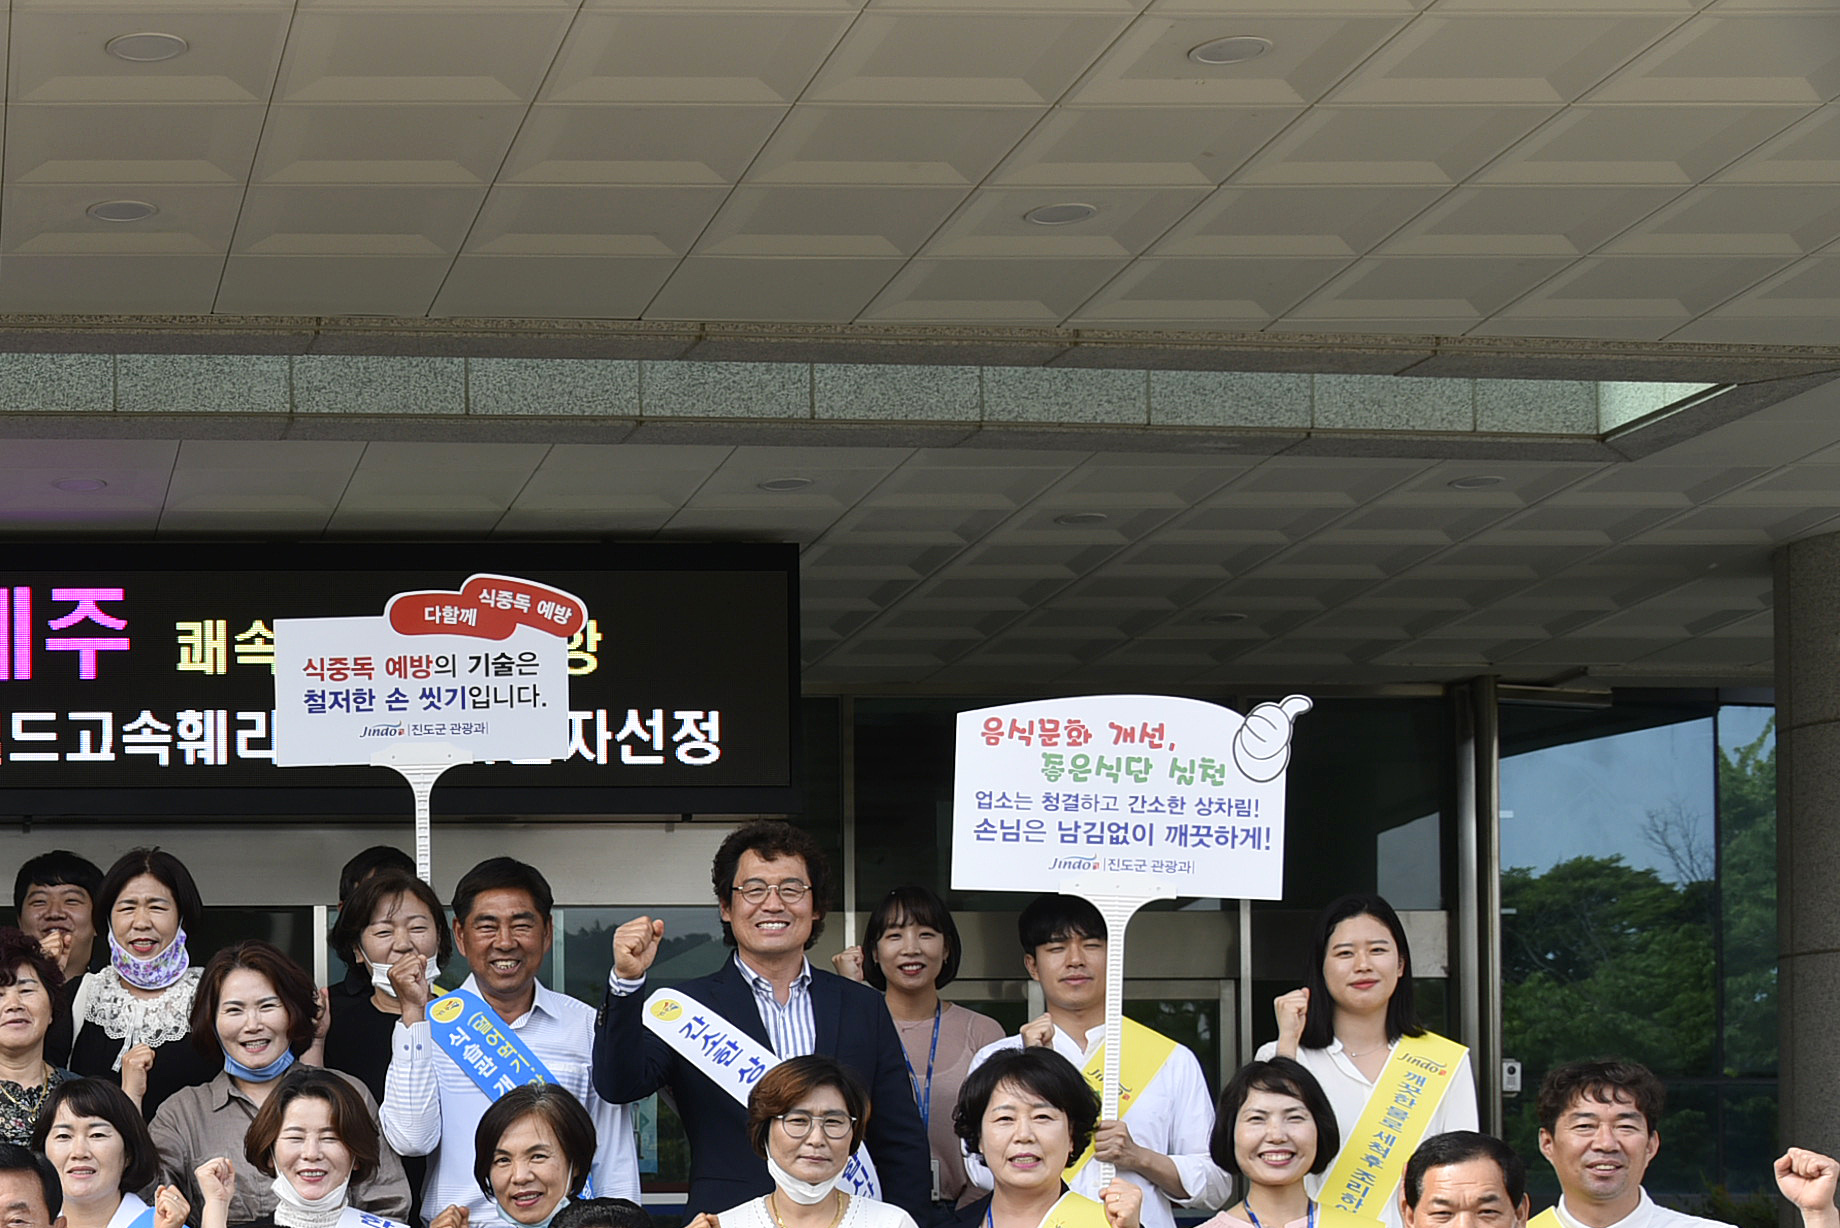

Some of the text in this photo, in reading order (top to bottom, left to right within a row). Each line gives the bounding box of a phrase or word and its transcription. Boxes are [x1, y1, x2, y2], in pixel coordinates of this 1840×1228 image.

[424, 605, 477, 626] 다함께
[479, 589, 572, 624] 식중독 예방
[303, 652, 539, 682] 식중독 예방의 기술은
[303, 684, 547, 714] 철저한 손 씻기입니다.
[360, 724, 397, 738] Jindo
[411, 723, 485, 736] 진도군 관광과
[981, 718, 1176, 751] 음식문화 개선,
[1169, 757, 1226, 786] 실천
[975, 791, 1259, 818] 업소는 청결하고 간소한 상차림!
[974, 818, 1271, 851] 손님은 남김없이 깨끗하게!
[1108, 858, 1191, 874] 진도군 관광과
[449, 1026, 498, 1078] 식습관
[679, 1016, 743, 1066] 간소한
